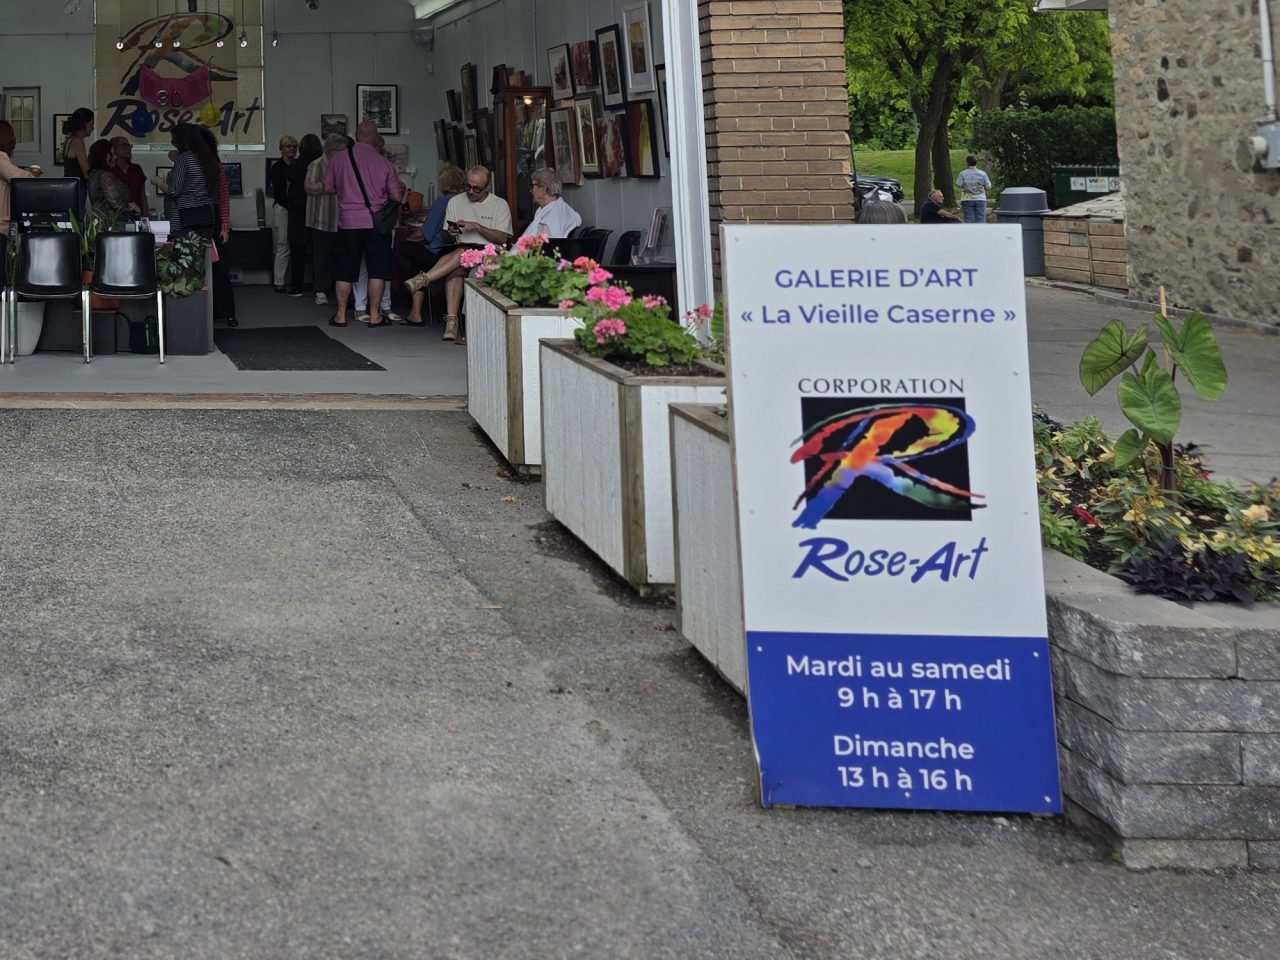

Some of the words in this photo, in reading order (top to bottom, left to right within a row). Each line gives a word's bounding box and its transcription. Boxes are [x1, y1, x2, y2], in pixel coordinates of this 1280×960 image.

[774, 268, 890, 289] GALERIE
[899, 267, 978, 288] D'ART
[761, 304, 792, 325] La
[797, 304, 879, 325] Vieille
[887, 304, 996, 324] Caserne
[797, 377, 966, 394] CORPORATION
[791, 536, 989, 584] Rose-Art
[786, 655, 862, 677] Mardi
[870, 660, 904, 678] au
[911, 658, 1012, 680] samedi
[838, 686, 855, 708] 9
[863, 687, 880, 708] h
[887, 687, 903, 709] à
[910, 689, 936, 710] 17
[945, 689, 962, 711] h
[833, 735, 975, 760] Dimanche
[838, 766, 865, 788] 13
[872, 766, 889, 788] h
[897, 767, 913, 789] à
[919, 768, 948, 790] 16
[956, 769, 973, 791] h
